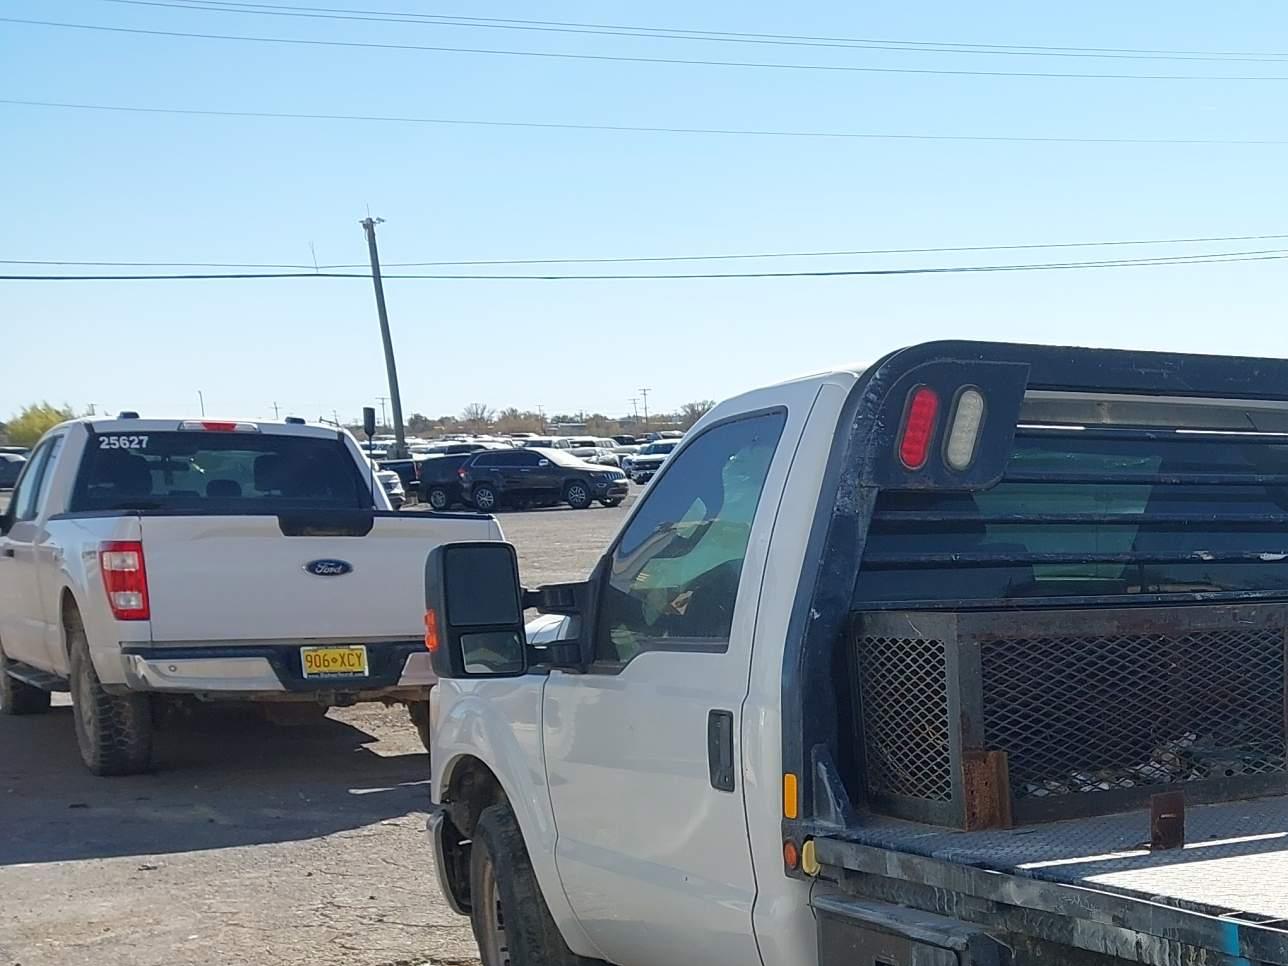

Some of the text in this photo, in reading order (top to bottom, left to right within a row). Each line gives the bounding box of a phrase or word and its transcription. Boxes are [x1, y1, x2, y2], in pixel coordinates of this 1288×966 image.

[98, 435, 149, 449] 25627
[305, 652, 362, 669] 906 XCY
